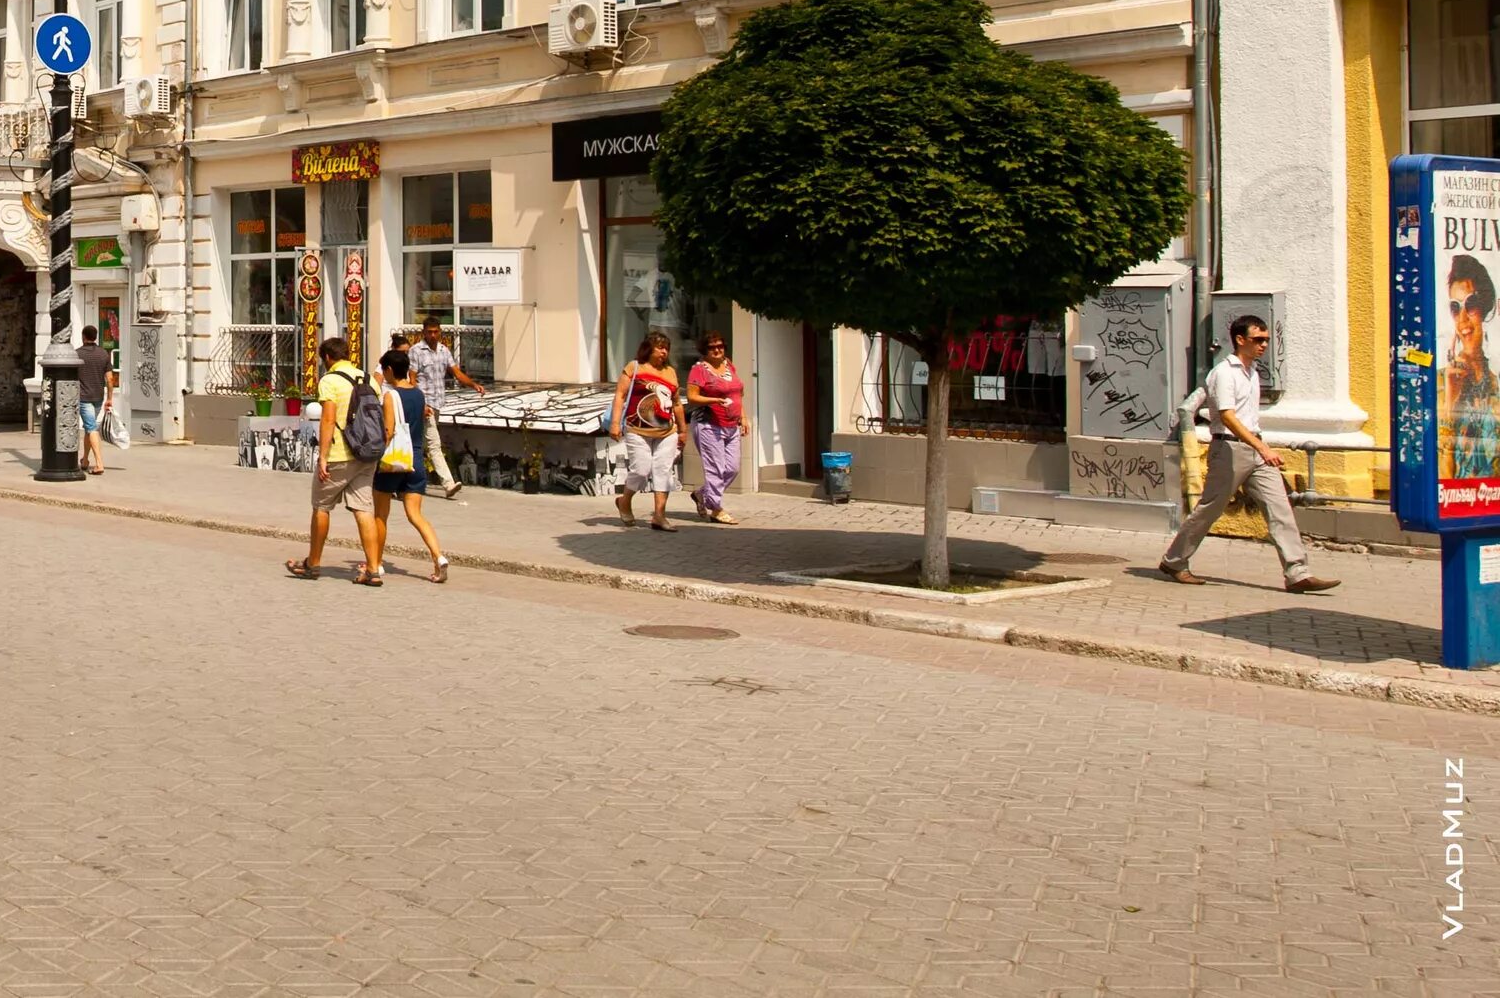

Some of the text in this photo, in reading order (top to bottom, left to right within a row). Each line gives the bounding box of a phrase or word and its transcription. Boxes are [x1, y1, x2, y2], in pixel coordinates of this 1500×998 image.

[303, 153, 360, 176] Вилена
[1443, 176, 1500, 193] МАГАЗИН С
[1446, 192, 1496, 210] ЖЕНСКОЙ
[463, 266, 512, 275] VATABAR
[1438, 484, 1476, 508] Бульвар
